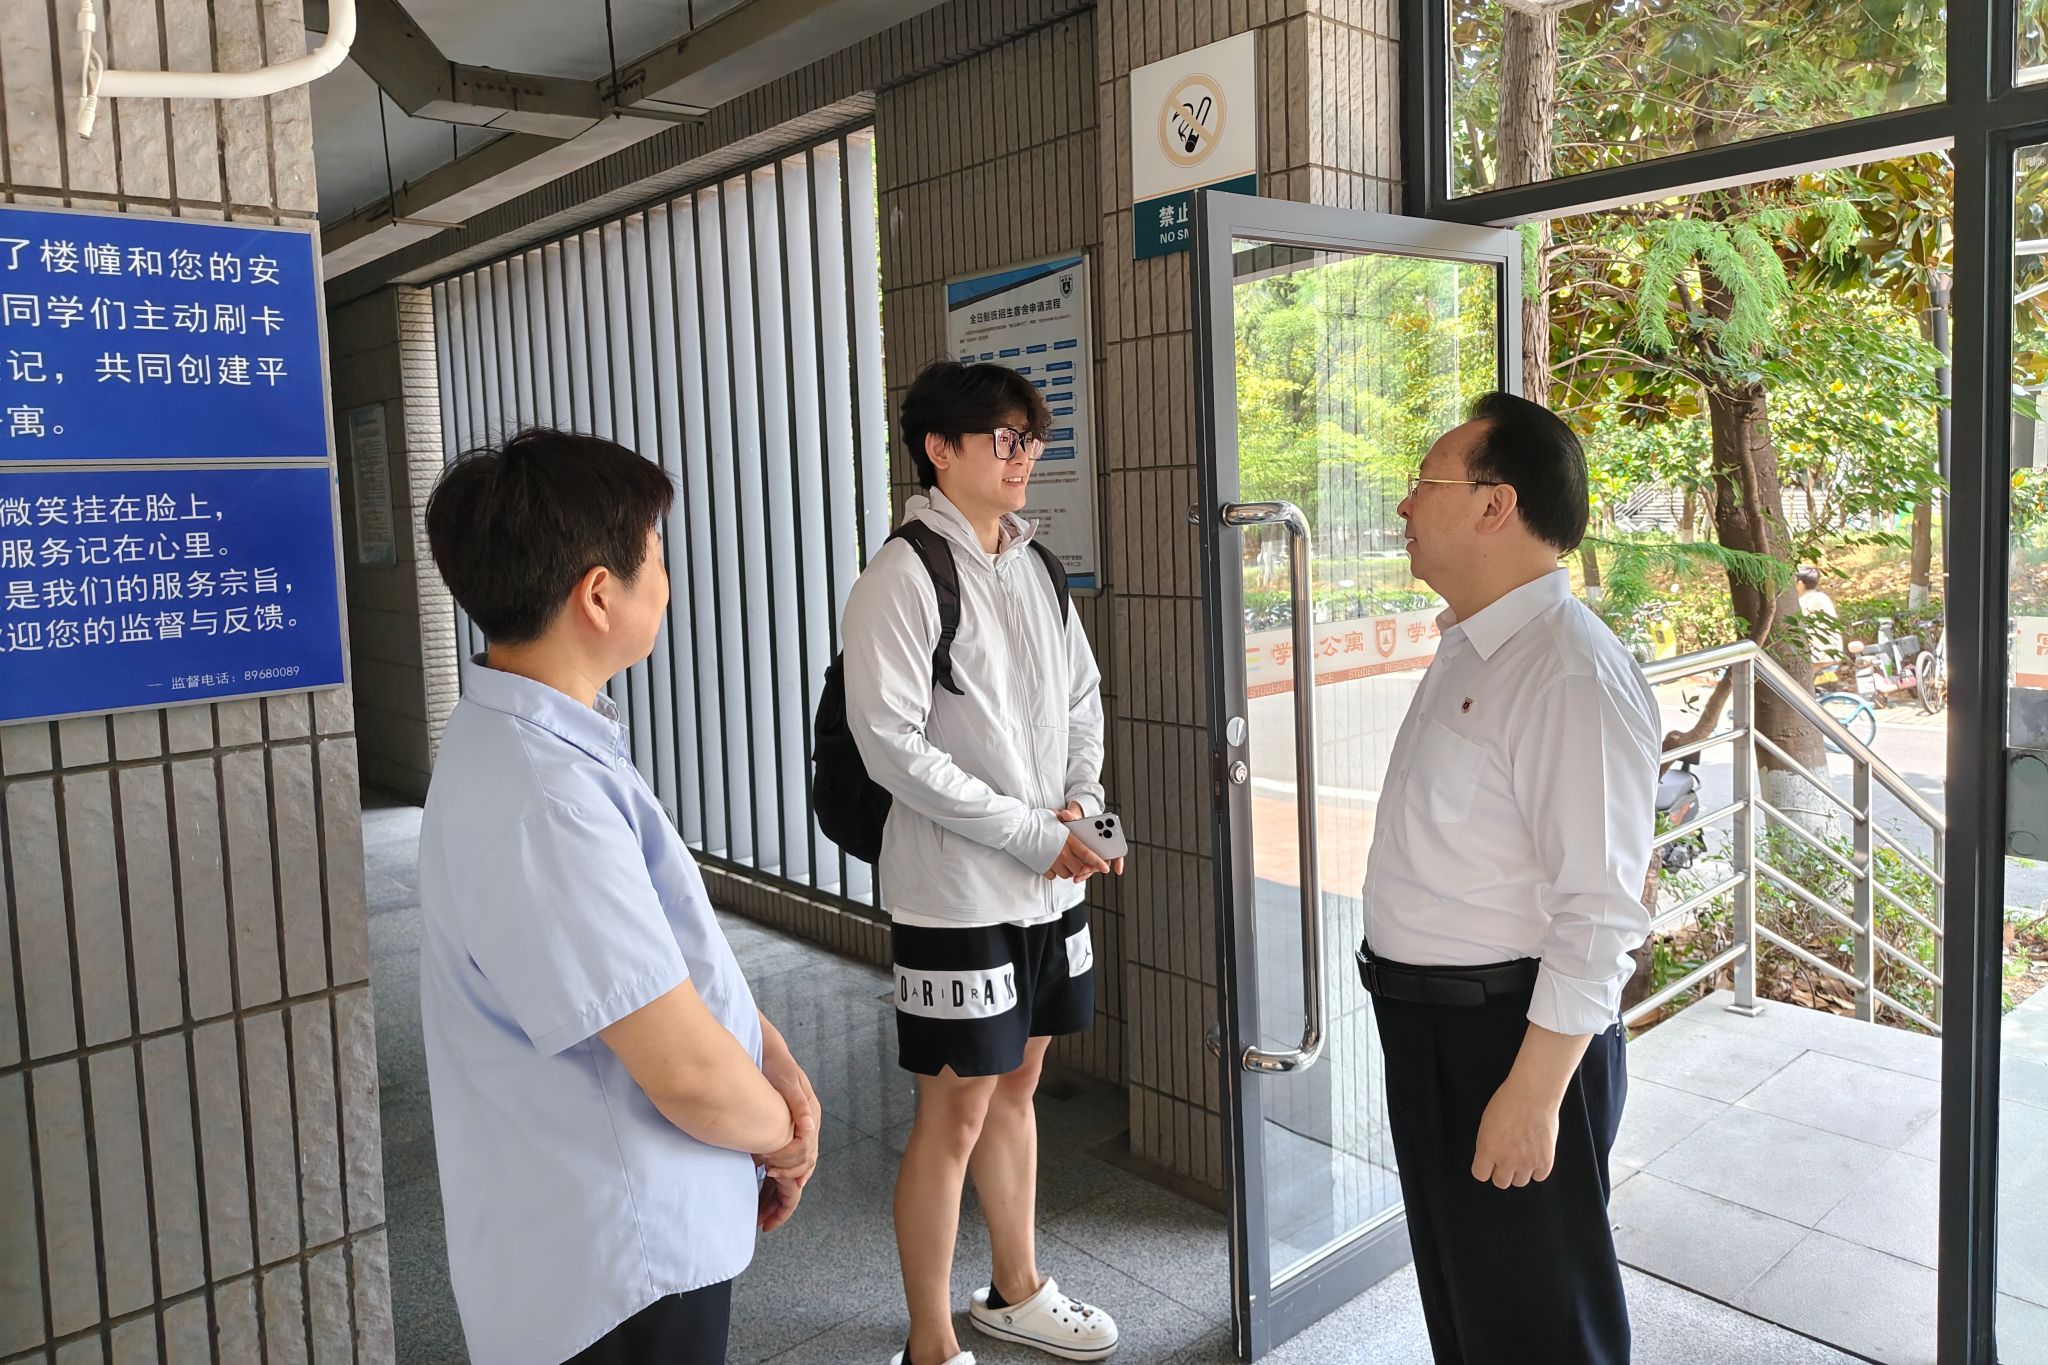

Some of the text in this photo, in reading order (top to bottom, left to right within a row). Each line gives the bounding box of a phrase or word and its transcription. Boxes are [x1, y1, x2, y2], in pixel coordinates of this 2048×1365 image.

[1160, 232, 1175, 244] NO
[0, 237, 280, 285] 了楼幢和您的安
[2, 293, 285, 336] 同学们主动刷卡
[0, 404, 64, 437] 寓。
[0, 493, 225, 527] 微笑挂在脸上，
[1, 531, 228, 569] 服务记在心里。
[5, 567, 293, 611] 是我们的服务宗旨，
[0, 603, 298, 652] 迎您的监督与反馈。
[1273, 631, 1364, 666] 学公寓
[1250, 682, 1287, 698] STUDENT
[1349, 664, 1380, 679] STUDENT
